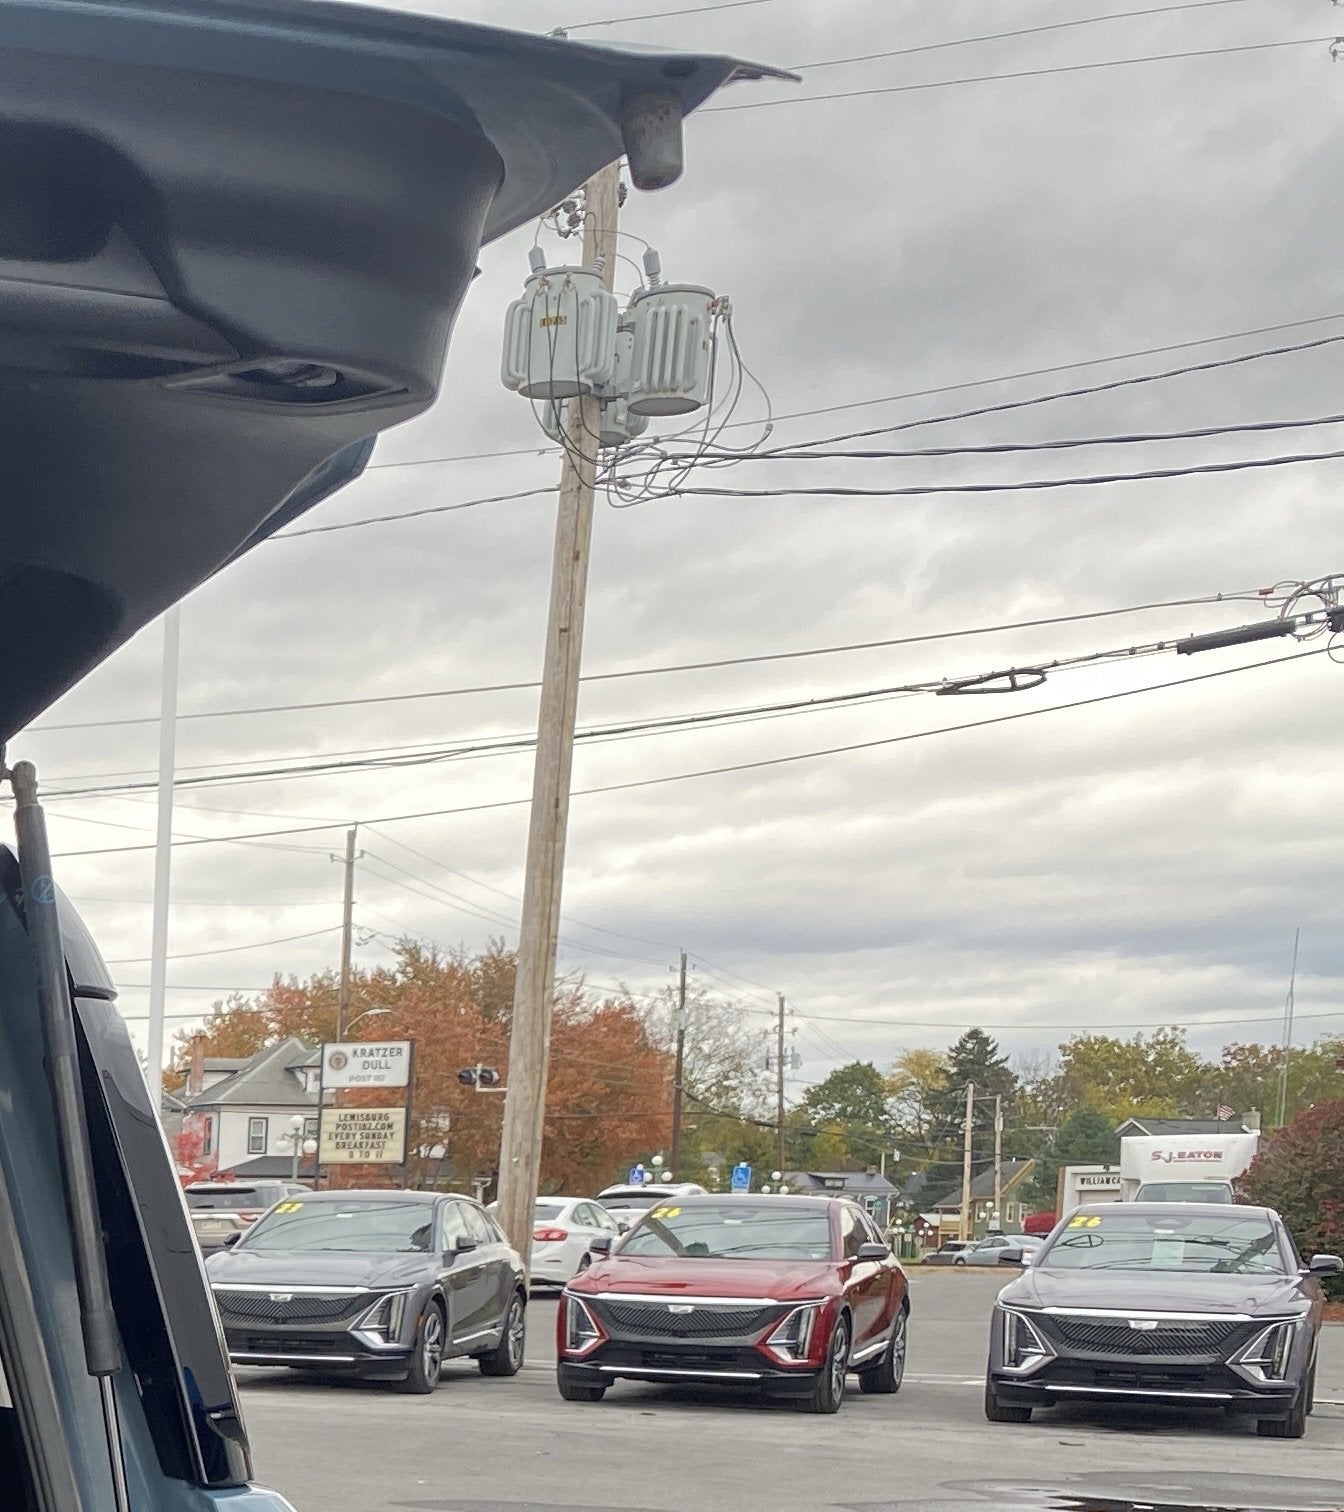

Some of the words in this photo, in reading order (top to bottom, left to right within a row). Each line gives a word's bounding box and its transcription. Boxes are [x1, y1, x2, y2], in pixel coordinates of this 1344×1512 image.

[352, 1047, 403, 1058] KRATZER
[362, 1060, 391, 1070] DULL
[338, 1113, 390, 1122] LEWISBURG
[328, 1132, 357, 1140] EVERY
[359, 1131, 395, 1140] SUNDAY
[335, 1141, 386, 1150] BREAKFAST
[1177, 1151, 1223, 1159] EATON
[1068, 1215, 1102, 1227] 26
